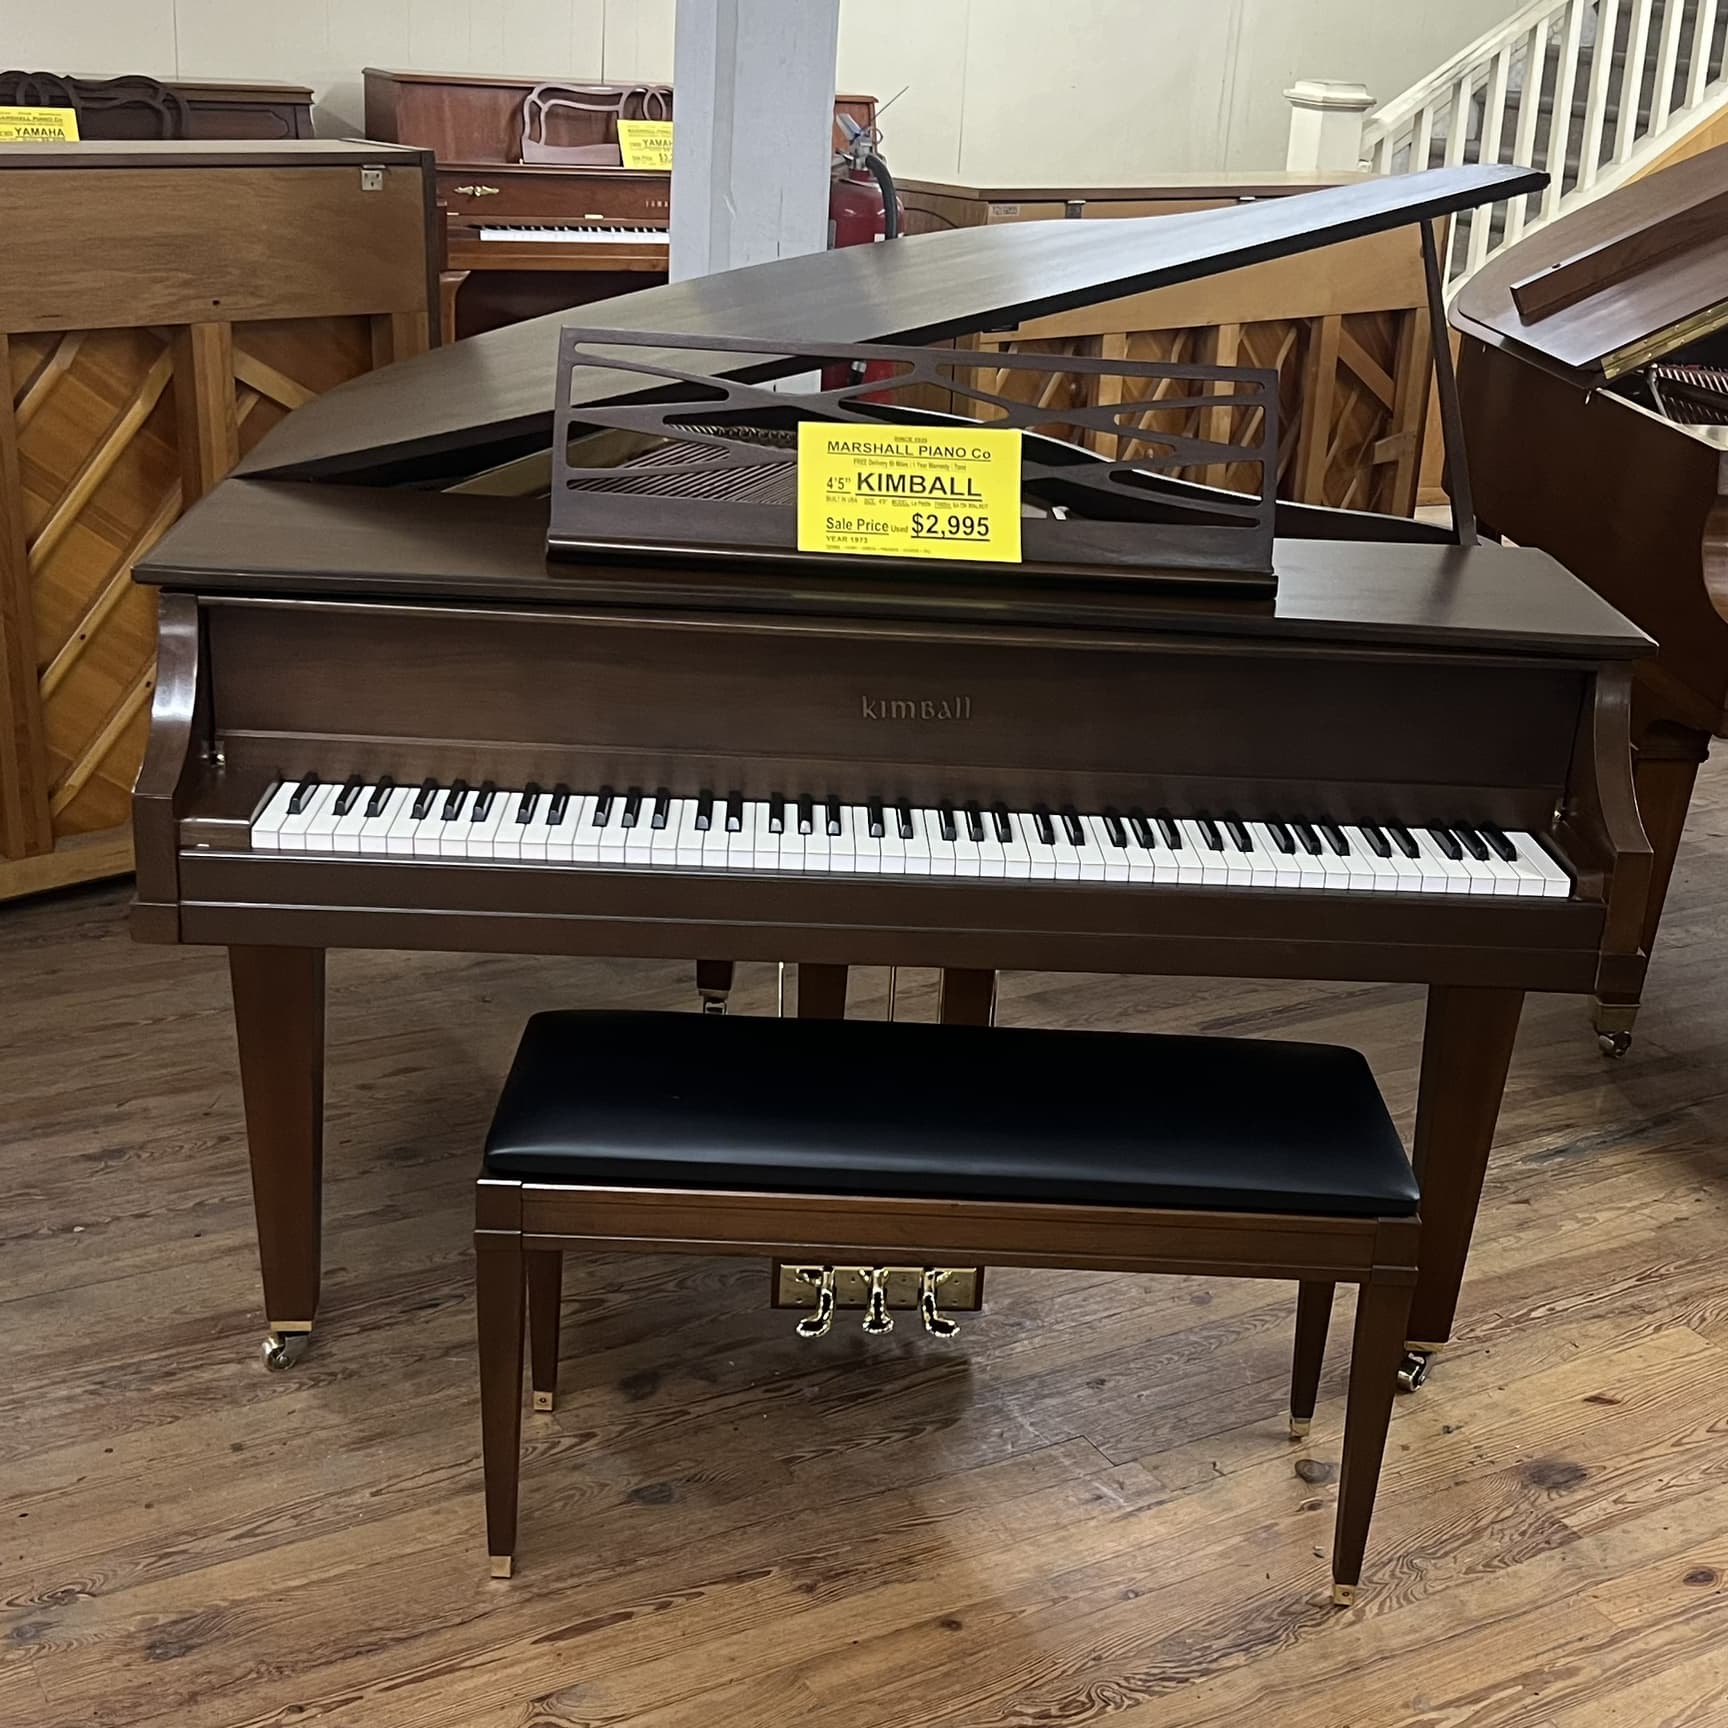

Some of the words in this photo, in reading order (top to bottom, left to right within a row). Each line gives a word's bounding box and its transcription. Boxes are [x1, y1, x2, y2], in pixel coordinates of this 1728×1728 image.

[15, 127, 65, 136] YAMAHA
[642, 139, 672, 147] YAMAH
[827, 440, 913, 455] MARSHALL
[919, 445, 966, 458] PIANO
[971, 447, 991, 459] Co
[857, 472, 982, 497] KIMBALL
[826, 517, 852, 530] Sale
[857, 518, 889, 532] Price
[891, 524, 908, 533] Used
[912, 512, 989, 538] $2,995
[826, 535, 848, 543] YEAR
